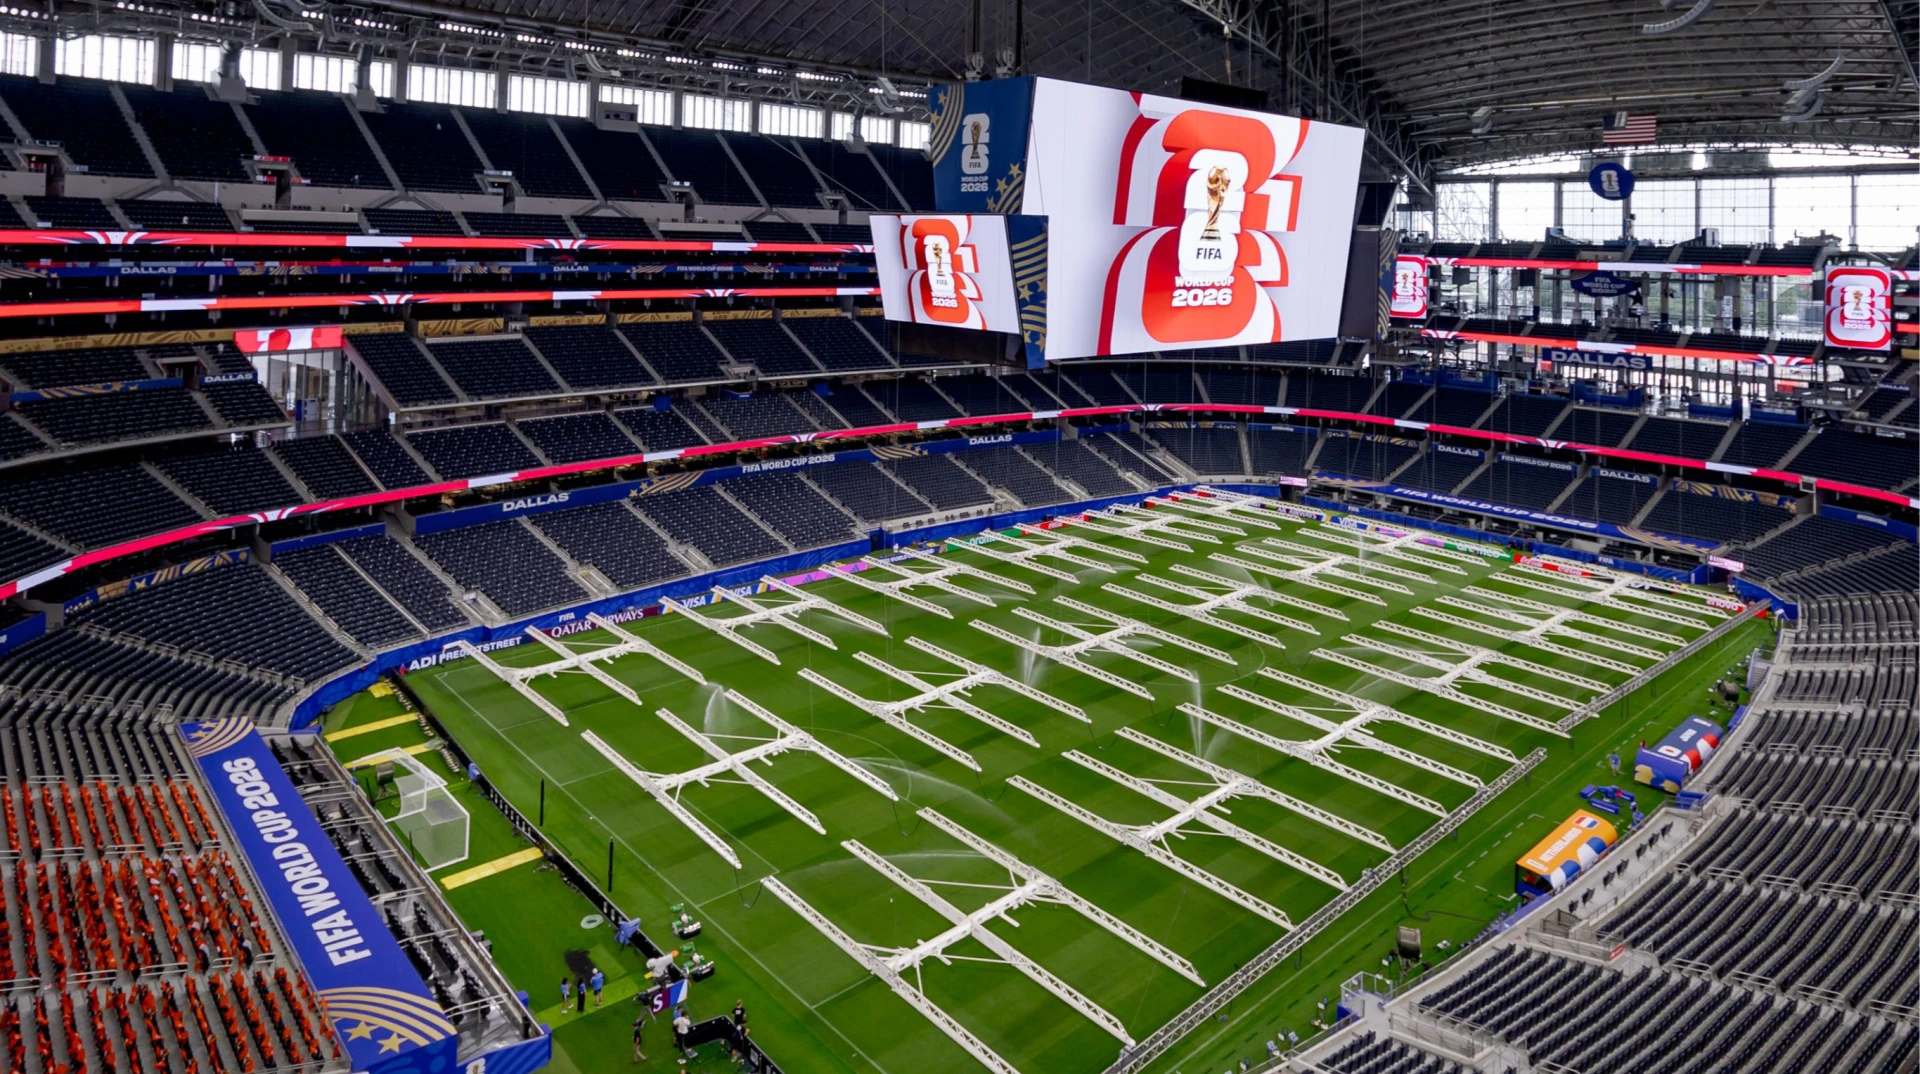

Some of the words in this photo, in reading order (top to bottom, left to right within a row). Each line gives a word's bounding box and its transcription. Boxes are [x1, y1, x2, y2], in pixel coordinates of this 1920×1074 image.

[961, 182, 988, 192] 2026
[1196, 248, 1222, 260] FIFA
[120, 266, 177, 274] DALLAS
[1174, 276, 1214, 288] WORLD
[1214, 275, 1235, 287] CUP
[932, 298, 958, 308] 2026
[1171, 288, 1233, 308] 2026
[1550, 351, 1647, 369] DALLAS
[204, 373, 253, 383] DALLAS
[969, 434, 1012, 446] DALLAS
[1438, 444, 1480, 457] DALLAS
[742, 464, 760, 474] FIFA
[761, 460, 790, 471] WORLD
[791, 457, 808, 467] CUP
[808, 454, 836, 465] 2026
[1501, 454, 1515, 462] FIFA
[1515, 456, 1536, 465] WORLD
[1550, 462, 1572, 471] 2026
[1600, 470, 1650, 483] DALLAS
[502, 492, 570, 512] DALLAS
[1394, 488, 1428, 498] FIFA
[1432, 494, 1492, 509] WORLD
[1492, 506, 1530, 515] CUP
[1529, 512, 1598, 528] 2026
[1598, 556, 1614, 564] FIFA
[682, 595, 707, 609] VISA
[558, 612, 576, 622] FIFA
[551, 620, 592, 638] QATAR
[409, 655, 436, 671] ADI
[222, 757, 279, 810] 2026
[251, 809, 298, 843] CUP
[272, 842, 341, 916] WORLD
[312, 909, 372, 966] FIFA
[652, 994, 664, 1012] S
